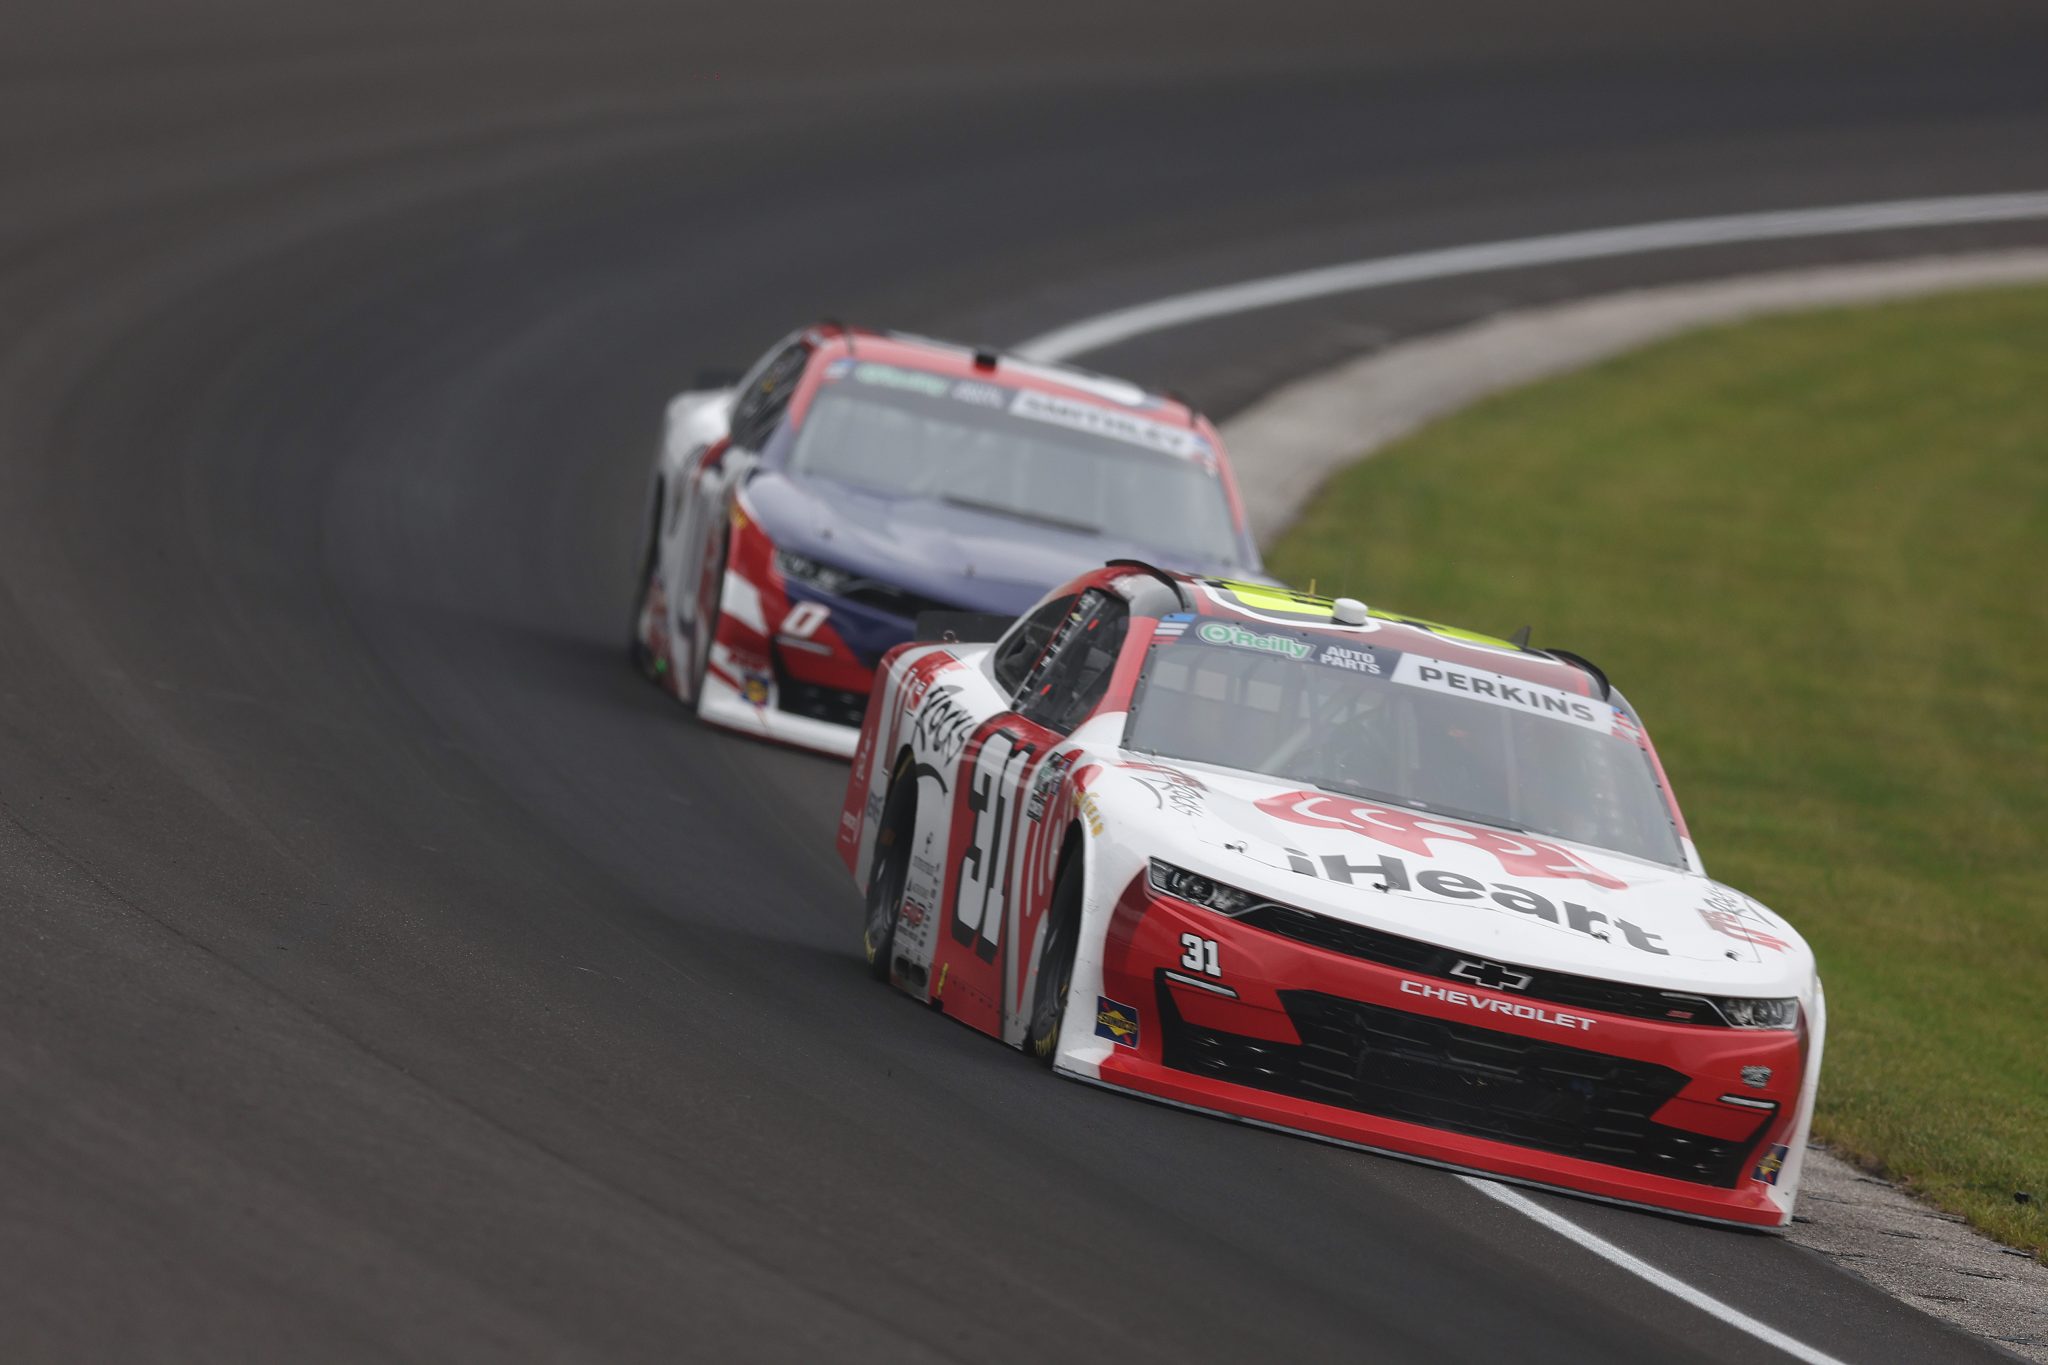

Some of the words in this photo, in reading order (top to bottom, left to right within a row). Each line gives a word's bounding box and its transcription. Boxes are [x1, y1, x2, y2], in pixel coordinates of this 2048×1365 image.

[780, 600, 831, 638] 0
[1198, 621, 1313, 661] O'Reilly
[1319, 653, 1381, 675] PARTS
[1325, 646, 1375, 665] AUTO
[1418, 664, 1597, 723] PERKINS
[953, 730, 1031, 952] 31
[1285, 847, 1669, 956] iHeart
[1179, 931, 1223, 978] 31
[1399, 979, 1598, 1032] CHEVROLET
